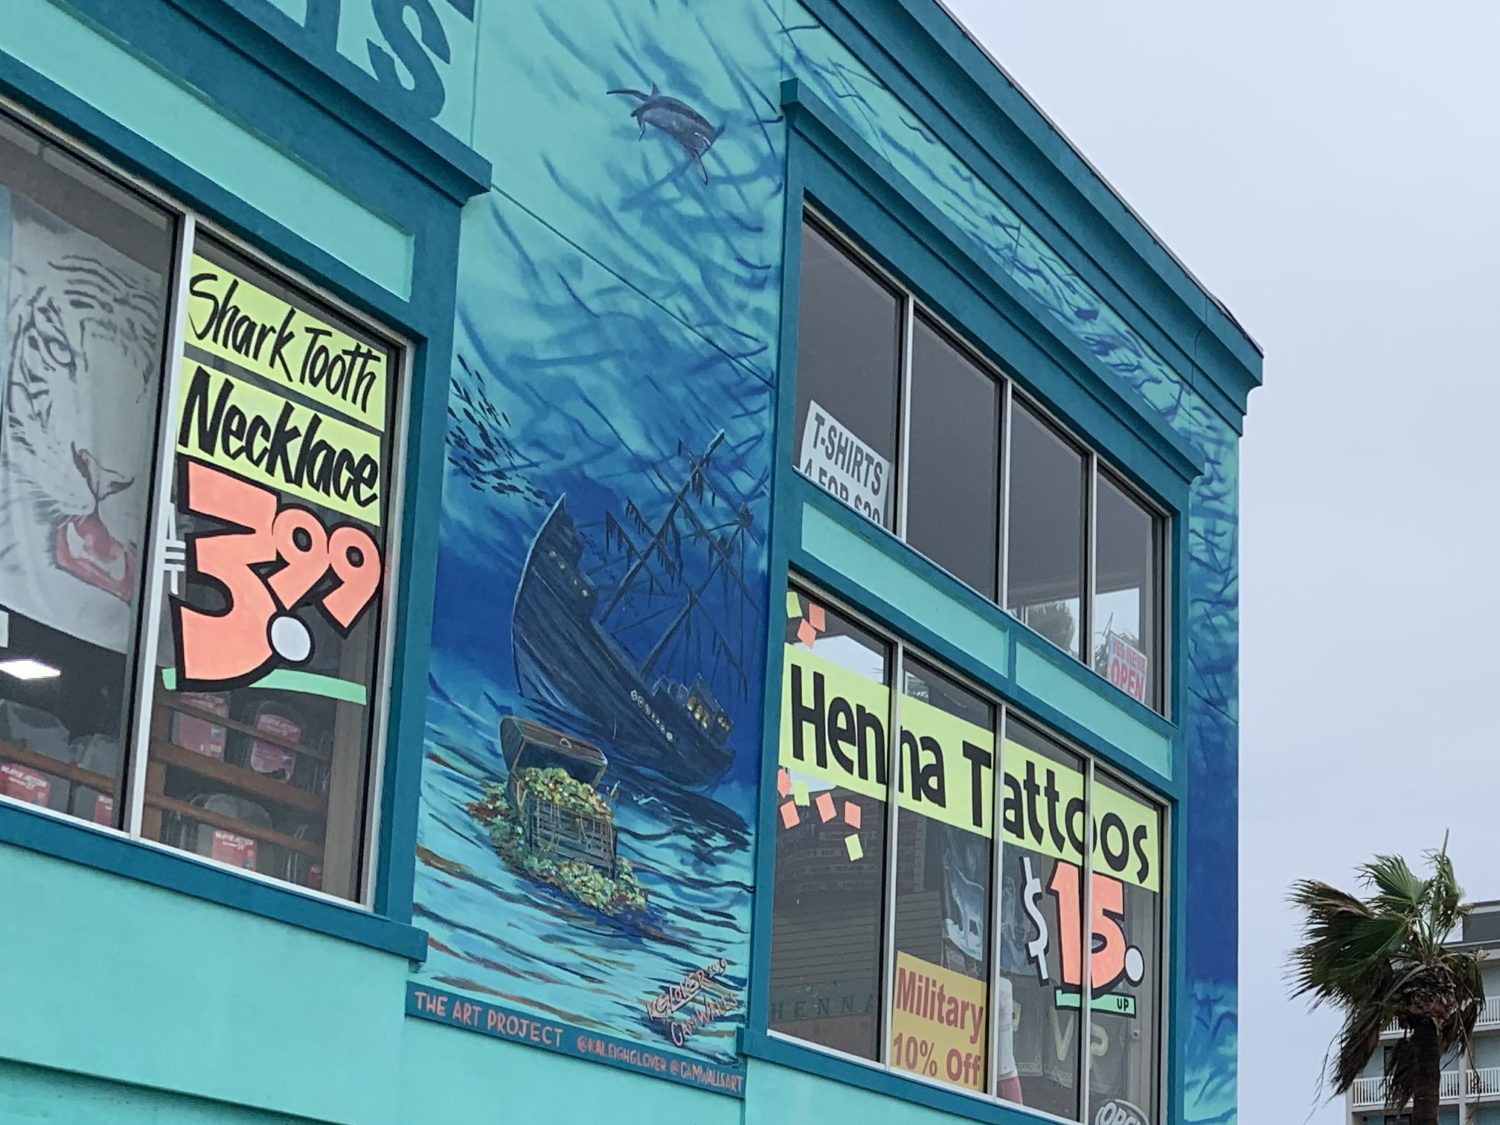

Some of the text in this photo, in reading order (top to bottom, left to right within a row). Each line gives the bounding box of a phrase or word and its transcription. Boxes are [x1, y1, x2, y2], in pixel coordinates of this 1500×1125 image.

[188, 273, 382, 414] Shark Tooth
[178, 366, 379, 508] Necklace
[813, 411, 883, 497] T-SHIRTS
[1109, 657, 1144, 703] OPEN
[790, 663, 947, 808] Henna
[961, 739, 1150, 885] Tattoos
[415, 991, 448, 1017] THE
[452, 1001, 482, 1028] ART
[487, 1009, 563, 1048] PROJECT
[896, 967, 984, 1045] Military
[1116, 998, 1130, 1012] UP
[893, 1032, 981, 1086] 10% Off
